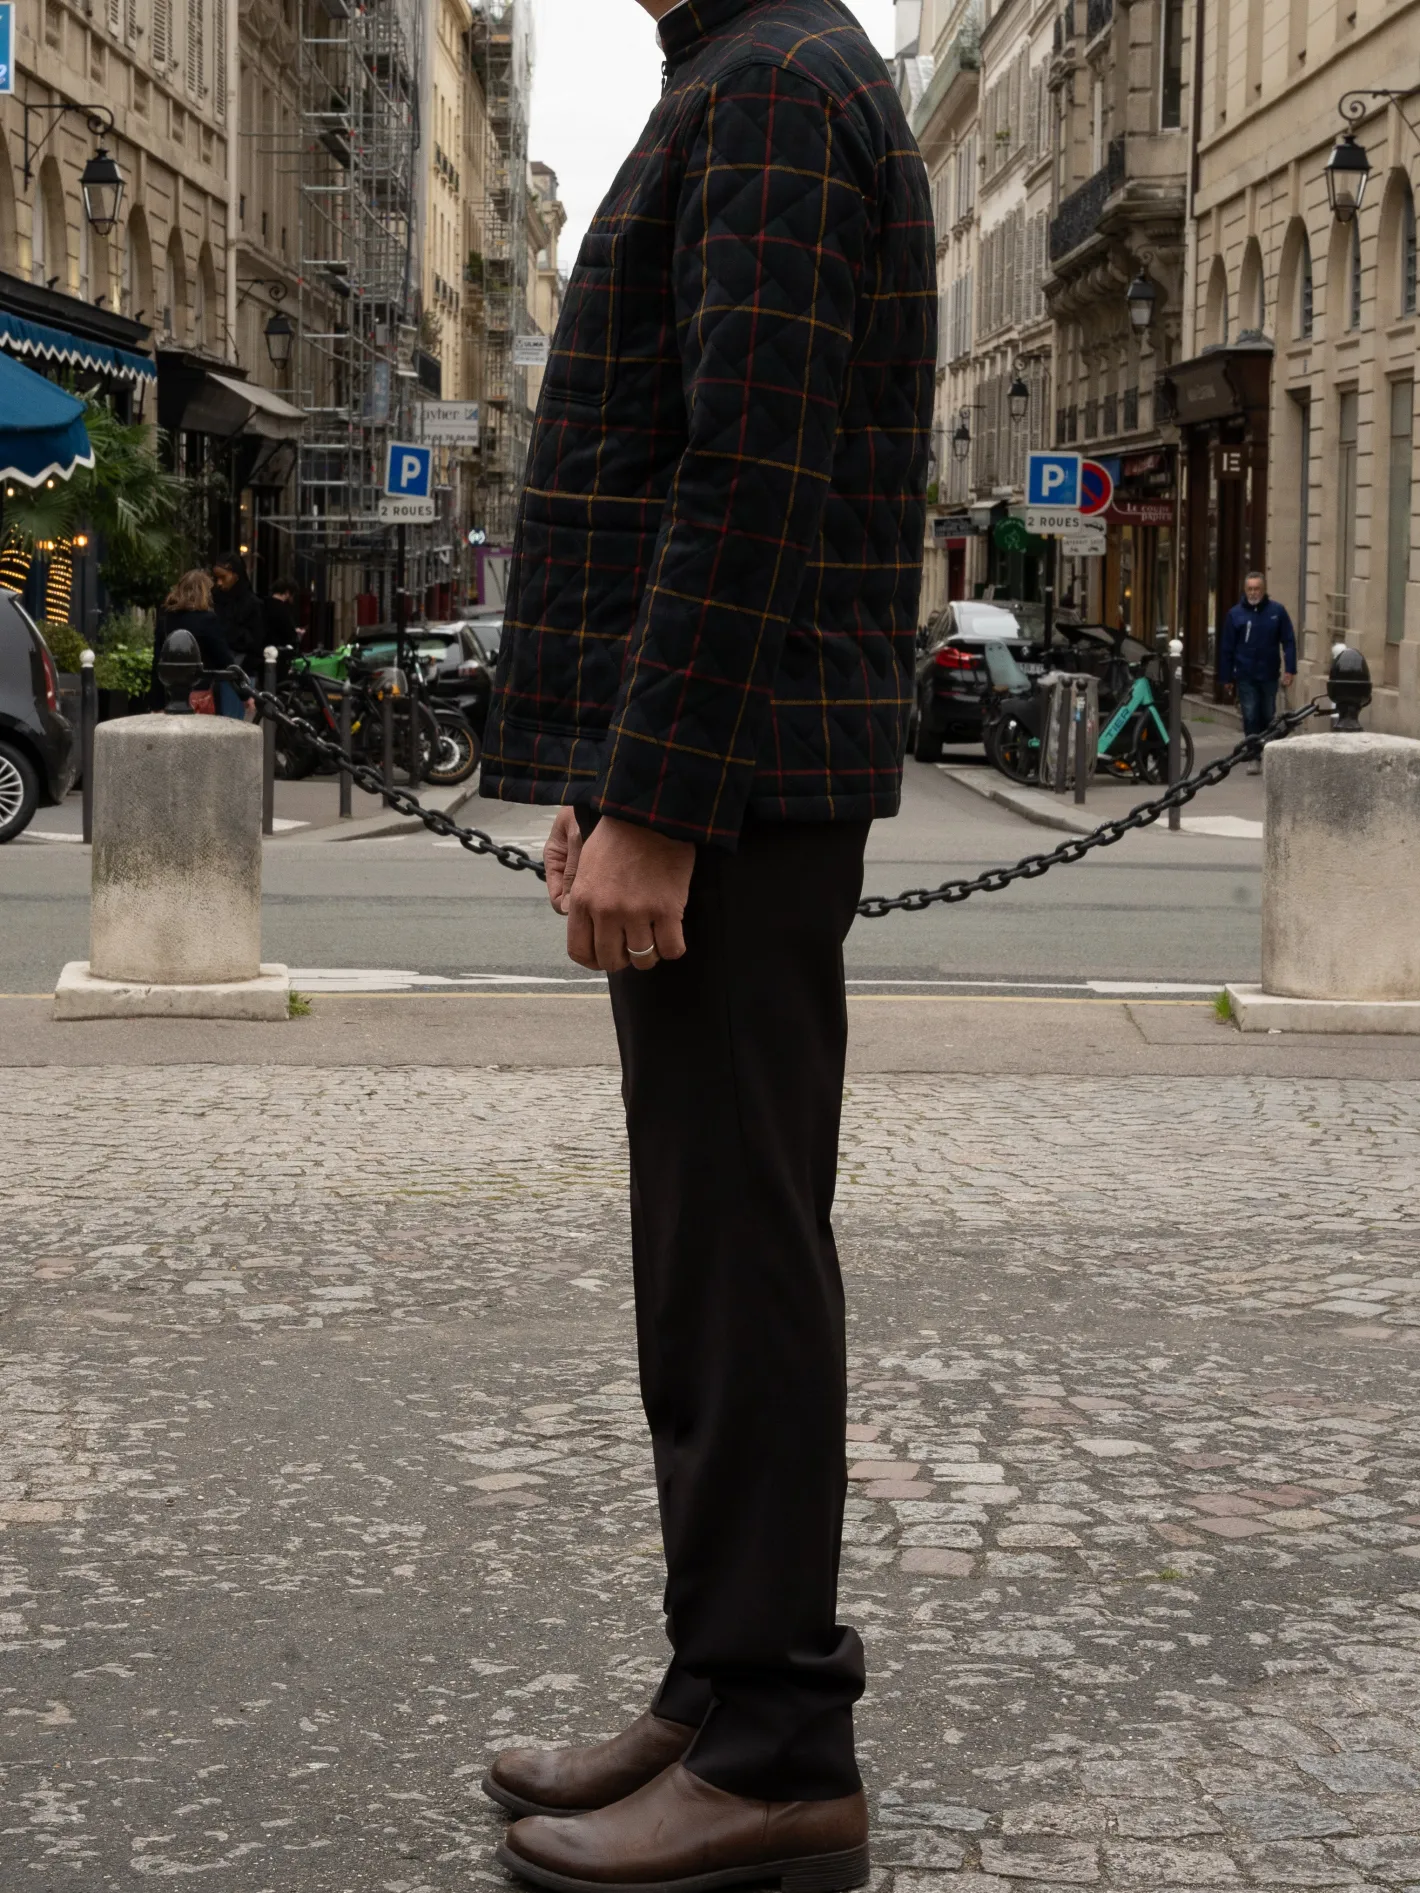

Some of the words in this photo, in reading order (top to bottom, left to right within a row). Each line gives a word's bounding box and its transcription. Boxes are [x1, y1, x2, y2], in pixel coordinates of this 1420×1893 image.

[401, 455, 421, 488] P
[1041, 464, 1065, 497] P
[381, 506, 388, 516] 2
[393, 506, 433, 516] ROUES
[1027, 516, 1035, 527] 2
[1040, 517, 1080, 527] ROUES
[1105, 708, 1130, 738] TIER
